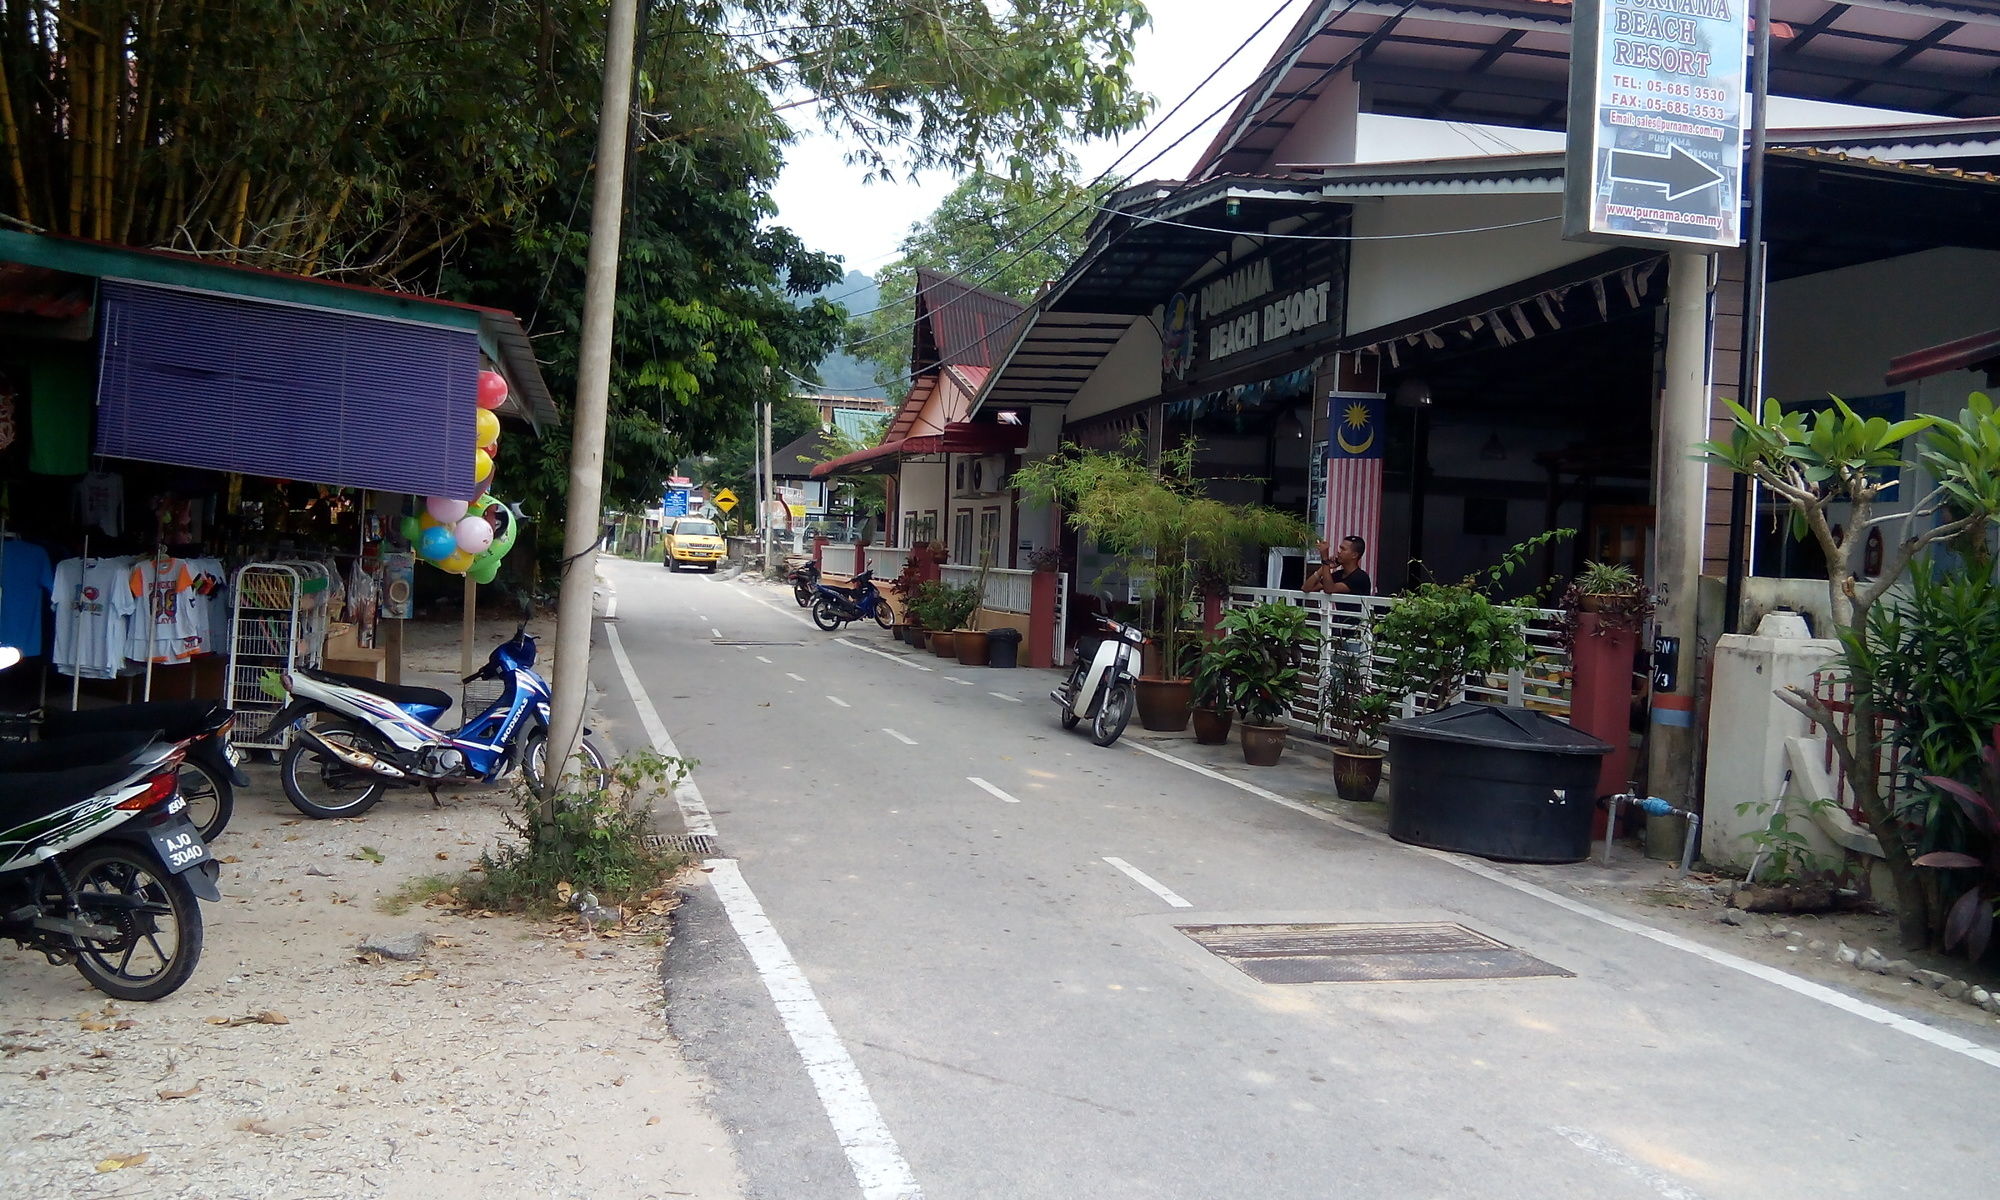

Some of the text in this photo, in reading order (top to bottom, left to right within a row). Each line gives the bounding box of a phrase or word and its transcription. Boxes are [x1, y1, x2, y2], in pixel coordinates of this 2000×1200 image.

[1616, 9, 1696, 44] BEACH
[1614, 40, 1710, 77] RESORT
[1613, 75, 1725, 102] TEL: 05-685 3530
[1612, 93, 1725, 120] FAX: 05-685 3533
[1610, 111, 1724, 141] Email: sales@purnama.com.my
[1648, 133, 1691, 147] PURNAMA
[1606, 203, 1723, 229] www.purnama.com.my
[1209, 280, 1331, 361] BEACH RESORT
[1655, 640, 1671, 654] SN
[500, 697, 529, 743] MODENAS
[169, 844, 203, 867] 3040
